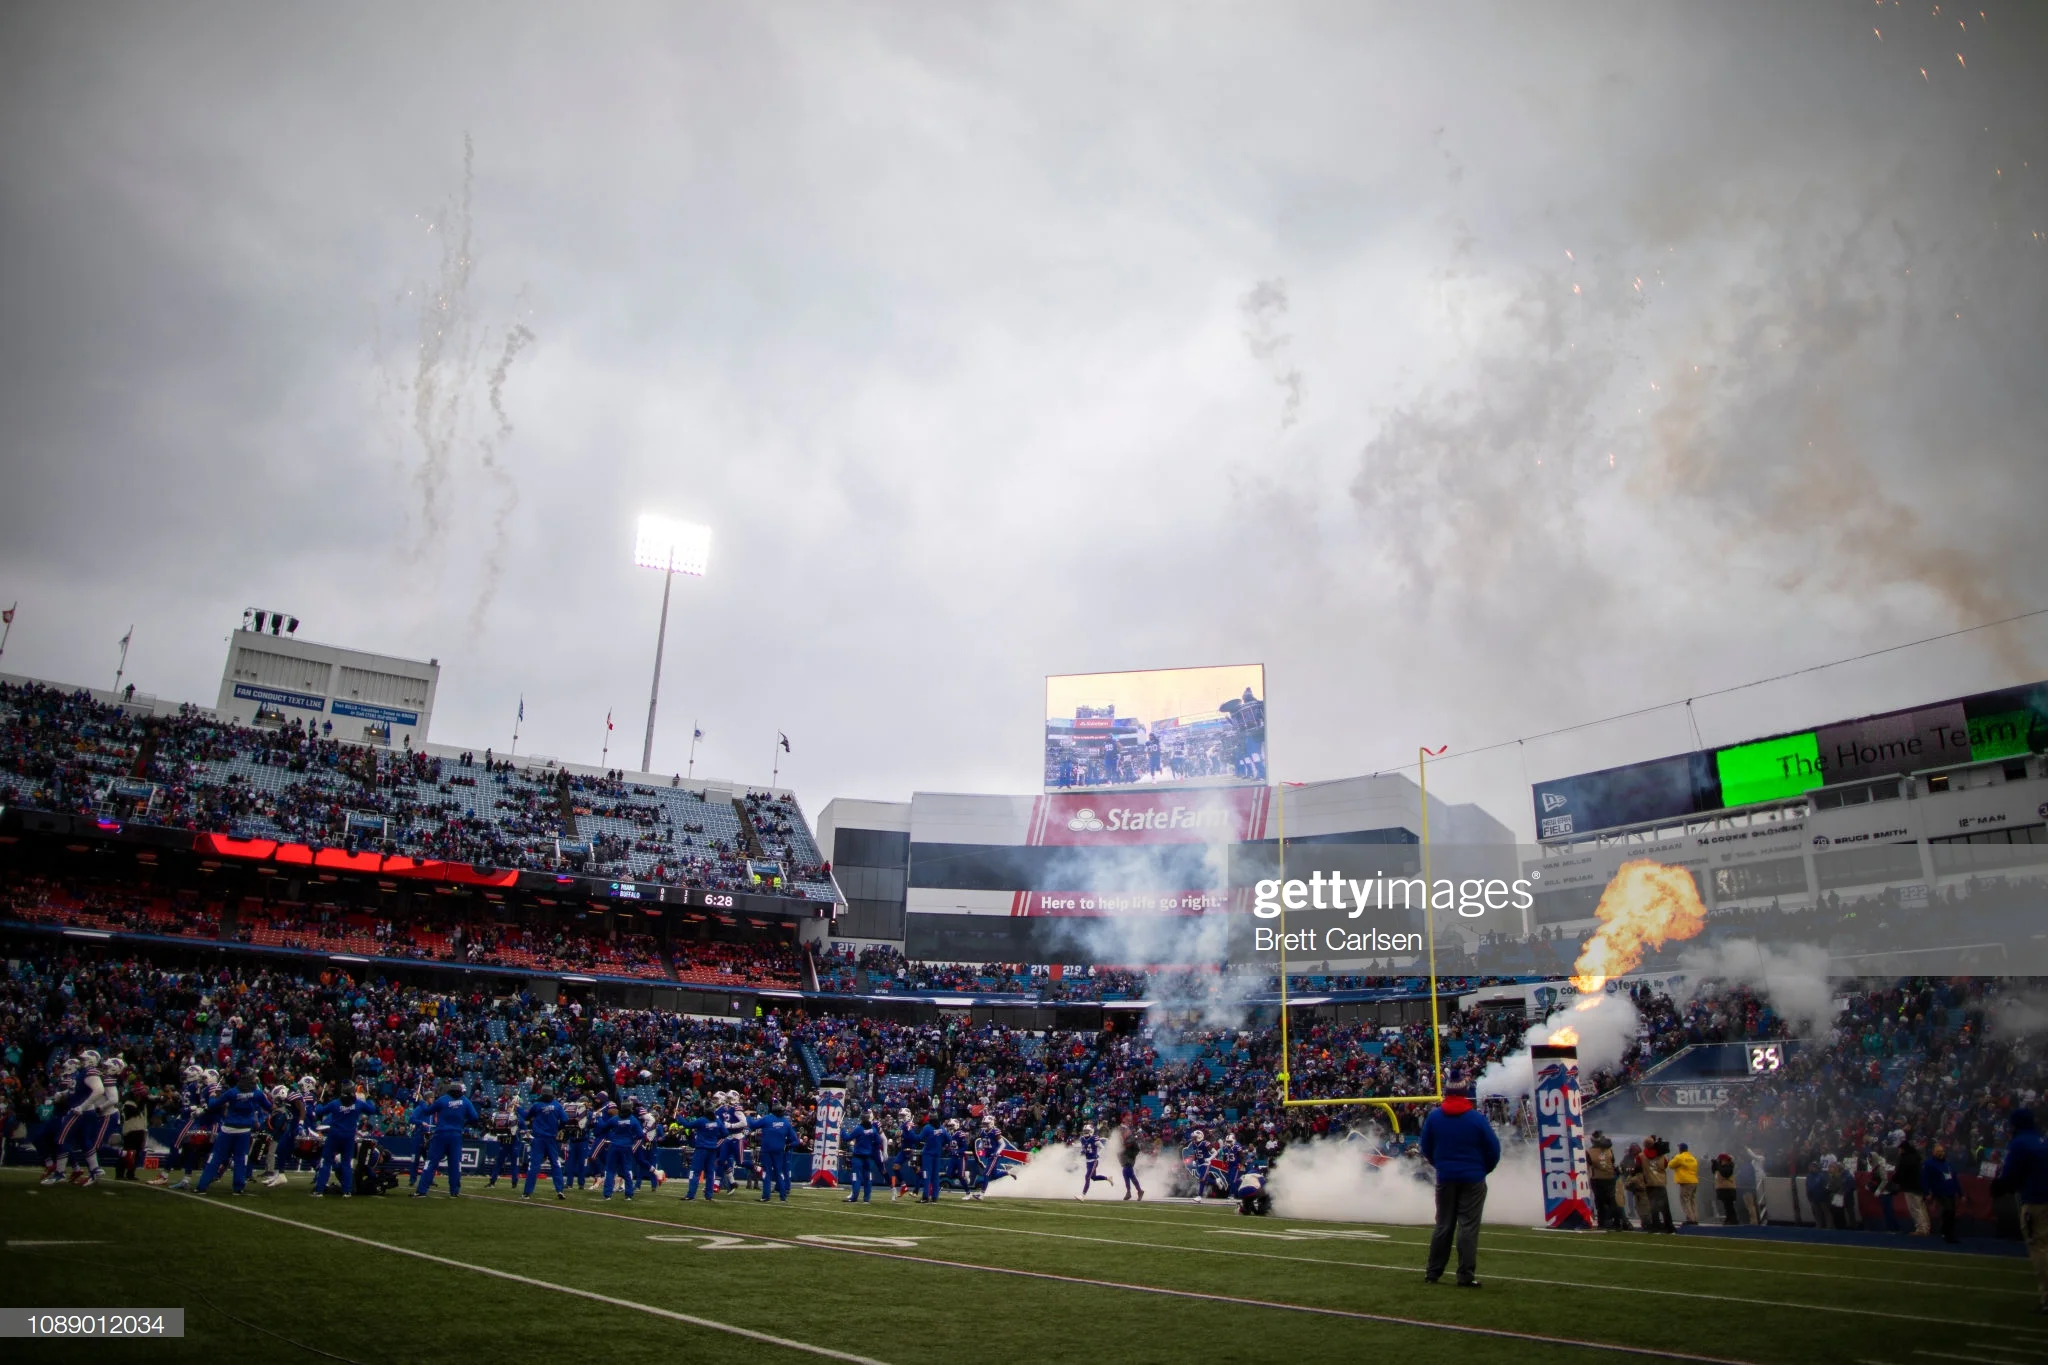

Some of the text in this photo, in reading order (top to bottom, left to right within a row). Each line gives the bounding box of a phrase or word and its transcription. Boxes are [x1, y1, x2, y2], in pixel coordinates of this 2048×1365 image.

[237, 687, 322, 708] FAN CONDUCT TEXT LINE
[1776, 752, 1829, 780] The
[1838, 735, 1923, 769] Home
[1929, 719, 2018, 752] Team
[1107, 807, 1230, 832] StateFarm
[1543, 818, 1557, 827] NEW
[1977, 814, 2007, 825] MAN
[1543, 823, 1572, 837] FIELD
[1834, 833, 1871, 845] BRUCE
[1874, 828, 1908, 839] SMITH
[619, 890, 641, 899] BUFFALO
[704, 893, 733, 908] 6:28
[1041, 895, 1076, 910] Here
[1079, 897, 1096, 910] to
[1098, 895, 1129, 912] help
[1132, 895, 1156, 909] life
[1160, 898, 1179, 911] go
[1751, 1047, 1780, 1071] 25
[1675, 1088, 1729, 1105] BILLS
[811, 1105, 828, 1171] BILLS
[823, 1105, 843, 1171] BILLS
[1538, 1087, 1574, 1200] BILLS
[1567, 1088, 1590, 1200] BILLS
